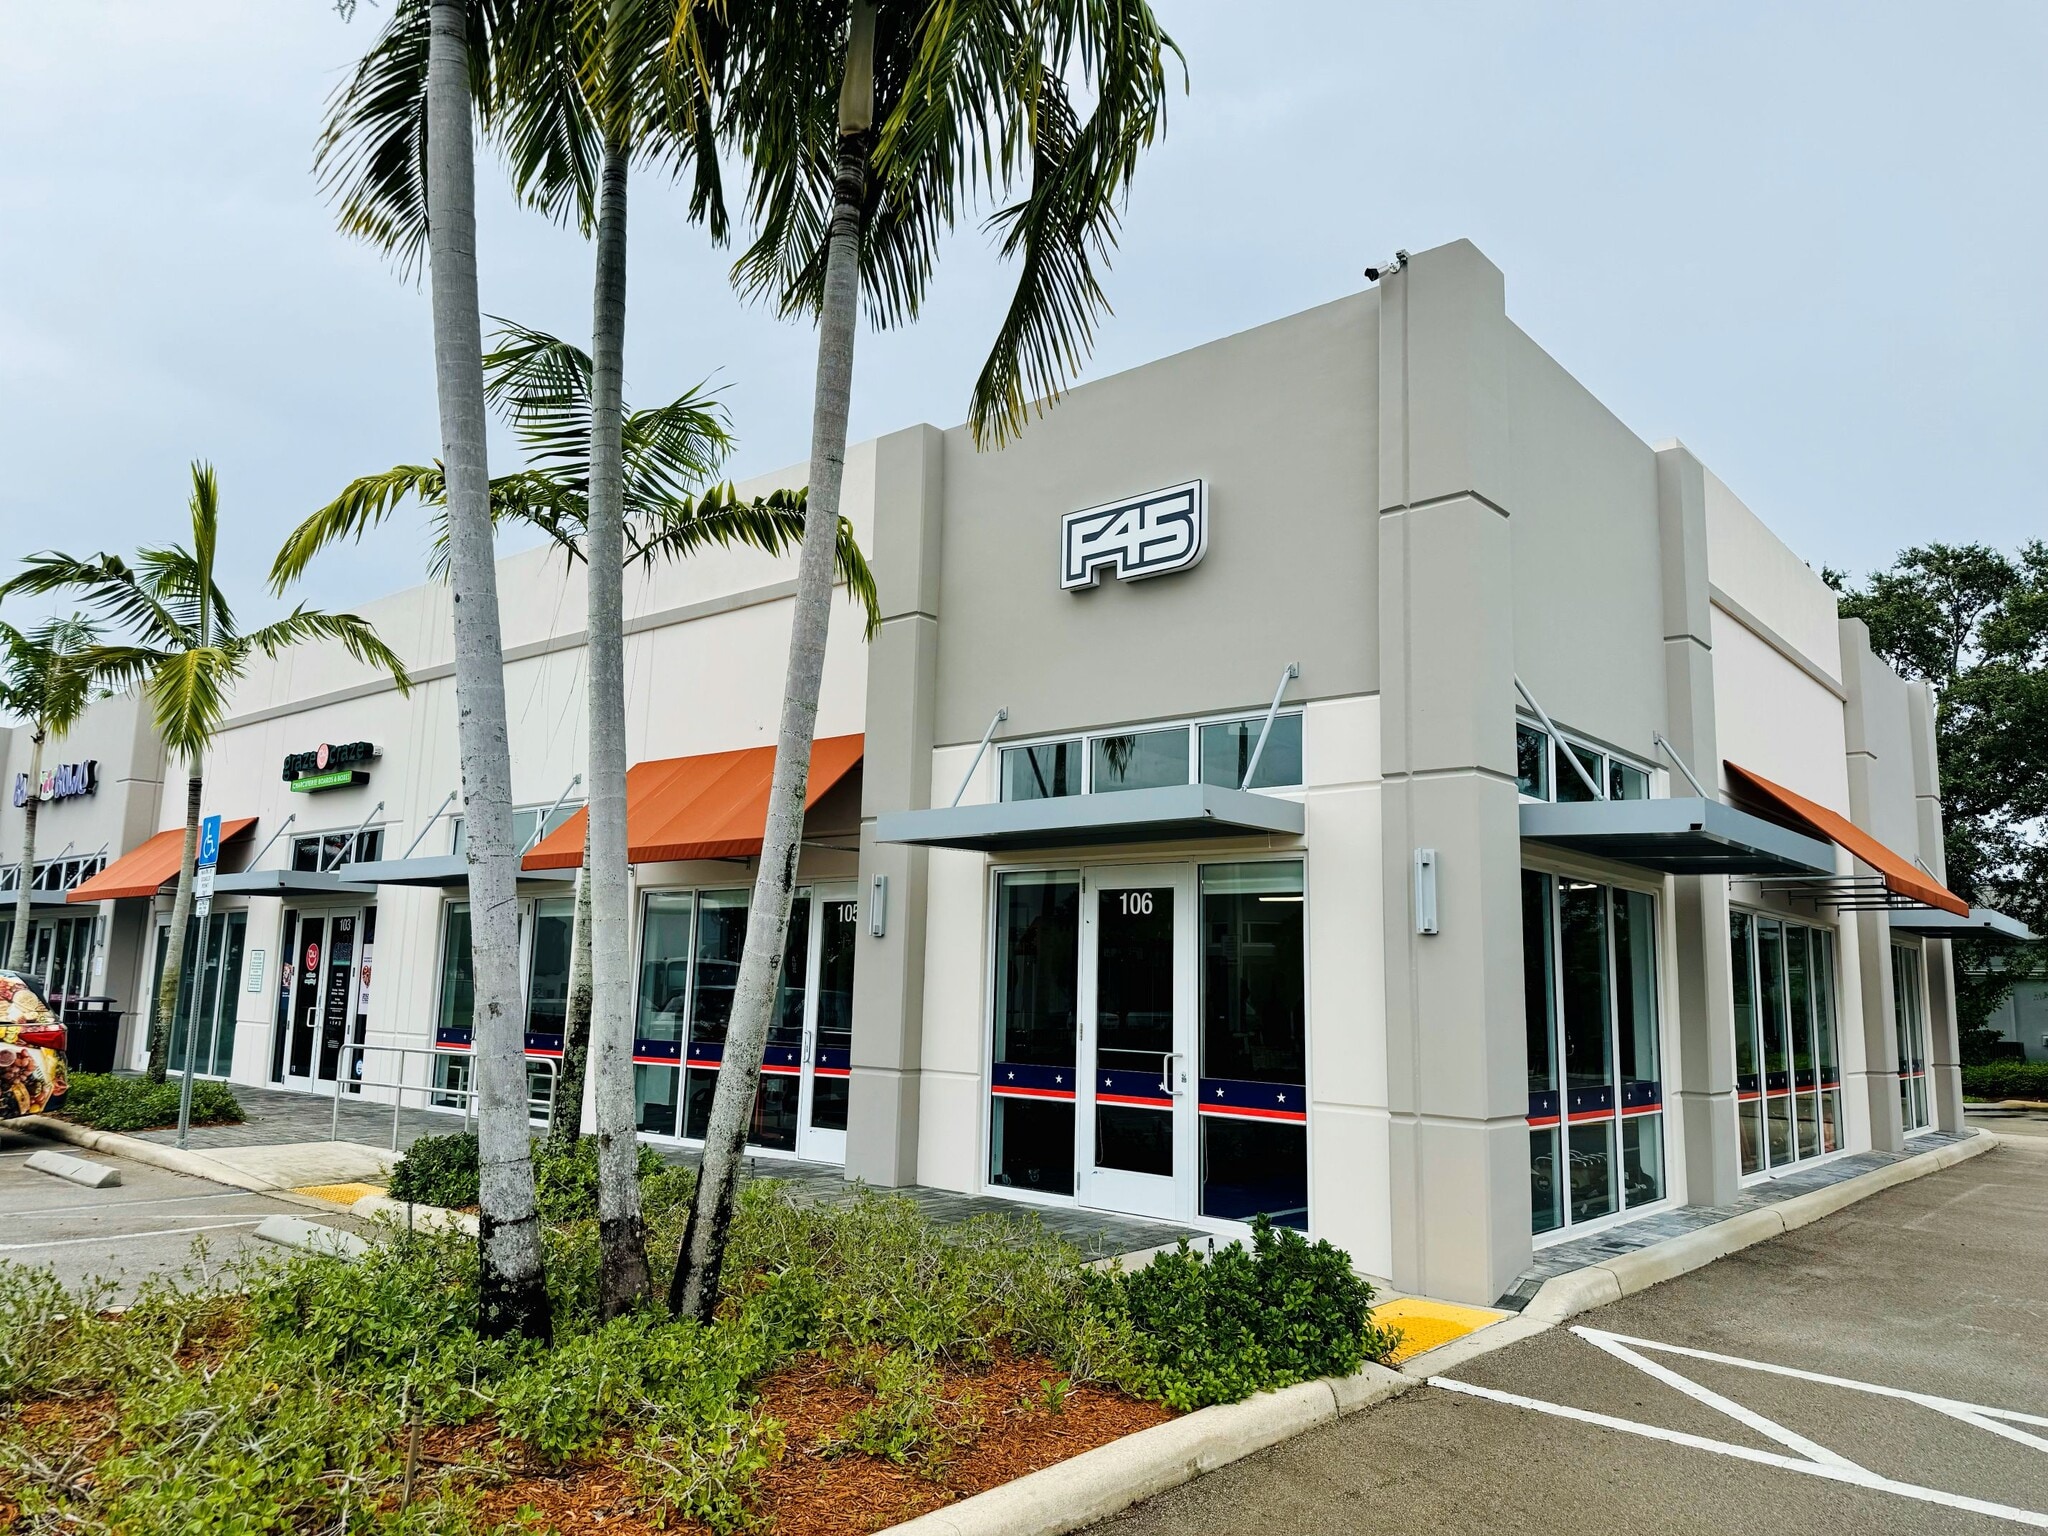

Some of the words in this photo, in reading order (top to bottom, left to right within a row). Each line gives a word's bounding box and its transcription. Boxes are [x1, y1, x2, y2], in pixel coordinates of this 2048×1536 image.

[1065, 487, 1196, 582] F45
[329, 742, 364, 763] craze
[1119, 892, 1153, 915] 106
[340, 918, 351, 931] 103
